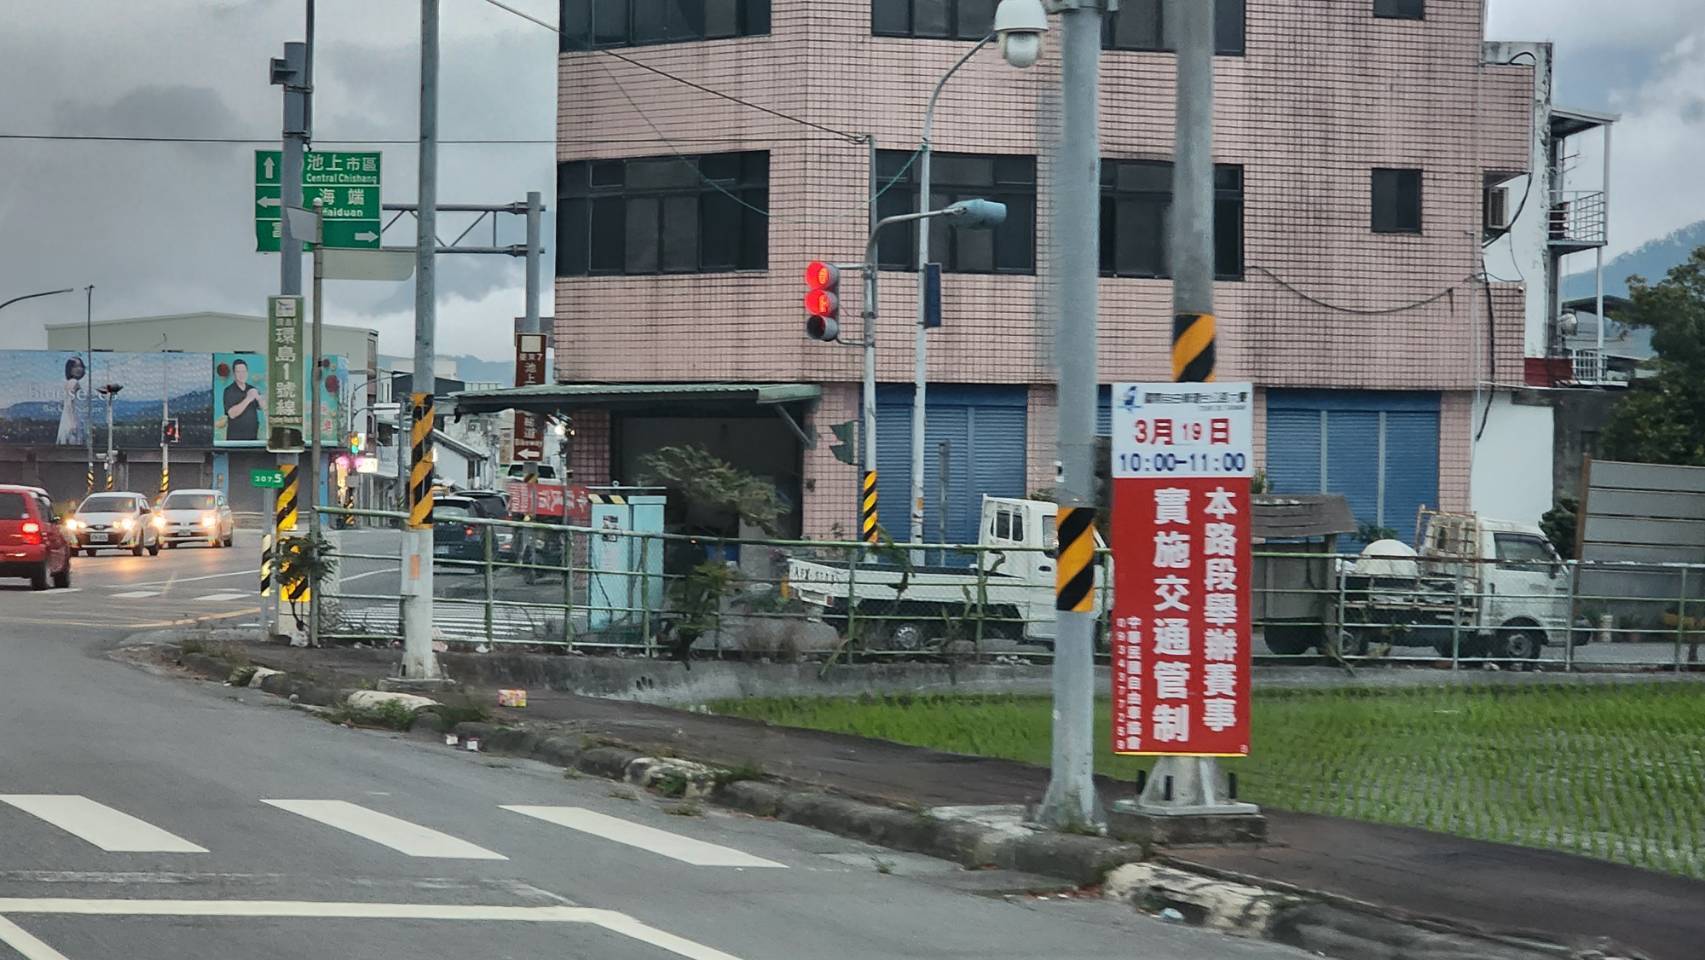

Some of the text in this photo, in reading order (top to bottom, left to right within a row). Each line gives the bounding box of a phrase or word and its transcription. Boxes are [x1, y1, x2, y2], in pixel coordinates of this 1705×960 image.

[307, 154, 377, 171] 池上市區
[306, 173, 377, 184] Central Chishang
[319, 188, 365, 206] 海端
[275, 327, 296, 415] 環島1號線
[1135, 418, 1230, 445] 3月19日
[1152, 487, 1191, 742] 實施交通管制
[1203, 486, 1238, 732] 本路段舉辦賽事
